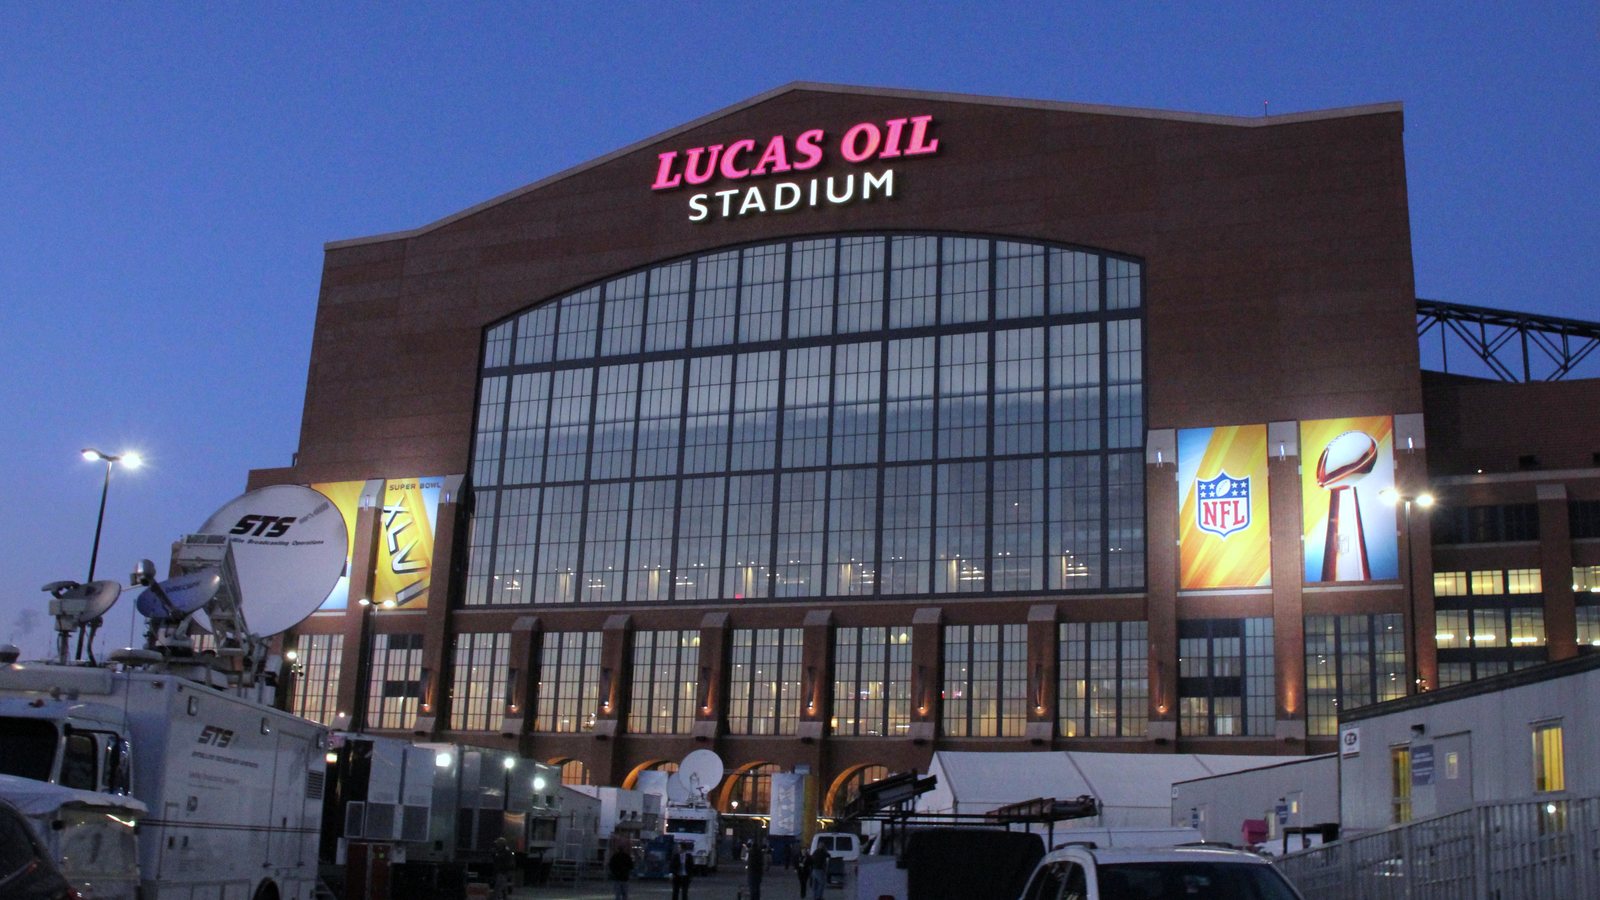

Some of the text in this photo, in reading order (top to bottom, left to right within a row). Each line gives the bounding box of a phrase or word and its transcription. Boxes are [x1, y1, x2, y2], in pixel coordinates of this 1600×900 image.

[652, 115, 940, 190] LUCAS OIL
[688, 169, 893, 222] STADIUM
[389, 483, 416, 491] SUPER
[229, 514, 297, 537] STS
[1203, 500, 1245, 529] NFL
[383, 494, 431, 607] XLVI
[198, 725, 234, 748] STS
